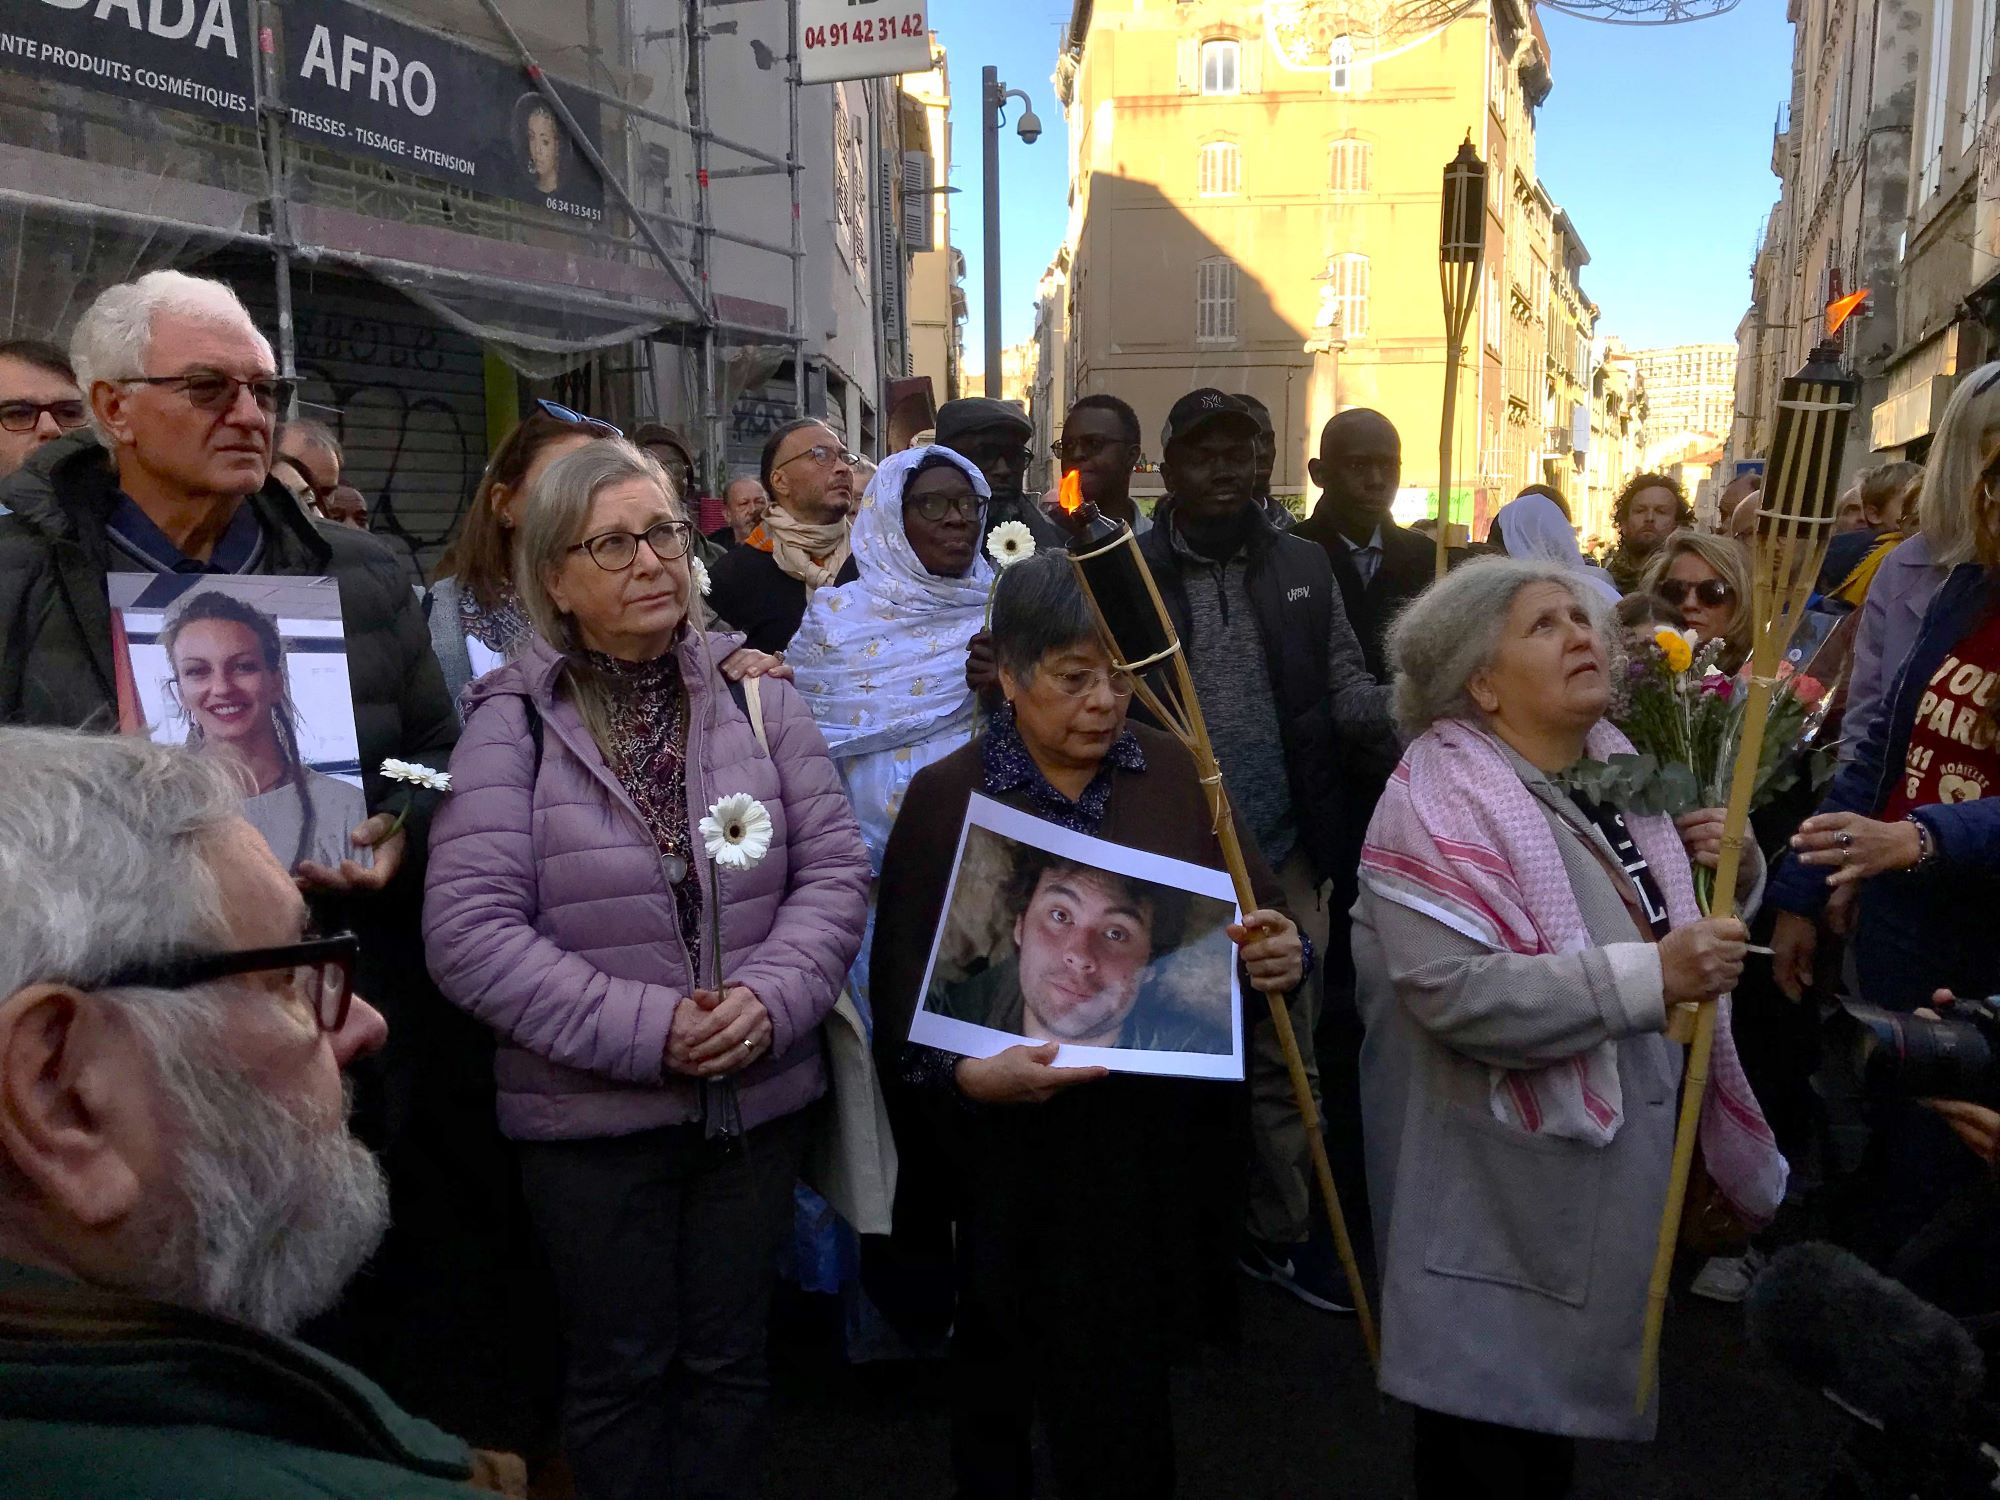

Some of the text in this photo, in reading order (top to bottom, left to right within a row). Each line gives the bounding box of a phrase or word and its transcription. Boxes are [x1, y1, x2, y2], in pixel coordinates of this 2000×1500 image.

[43, 0, 238, 59] ADA
[805, 13, 923, 49] 04 91 42 31 42
[0, 33, 37, 59] NTE
[41, 43, 131, 82] PRODUITS
[134, 69, 247, 112] COSMÉTIQUES
[300, 24, 437, 117] AFRO
[290, 107, 346, 137] TRESSES
[355, 127, 405, 155] TISSAGE
[413, 145, 475, 176] EXTENSION
[546, 197, 557, 209] 06
[558, 199, 569, 212] 34
[570, 203, 581, 216] 13
[582, 206, 592, 219] 54
